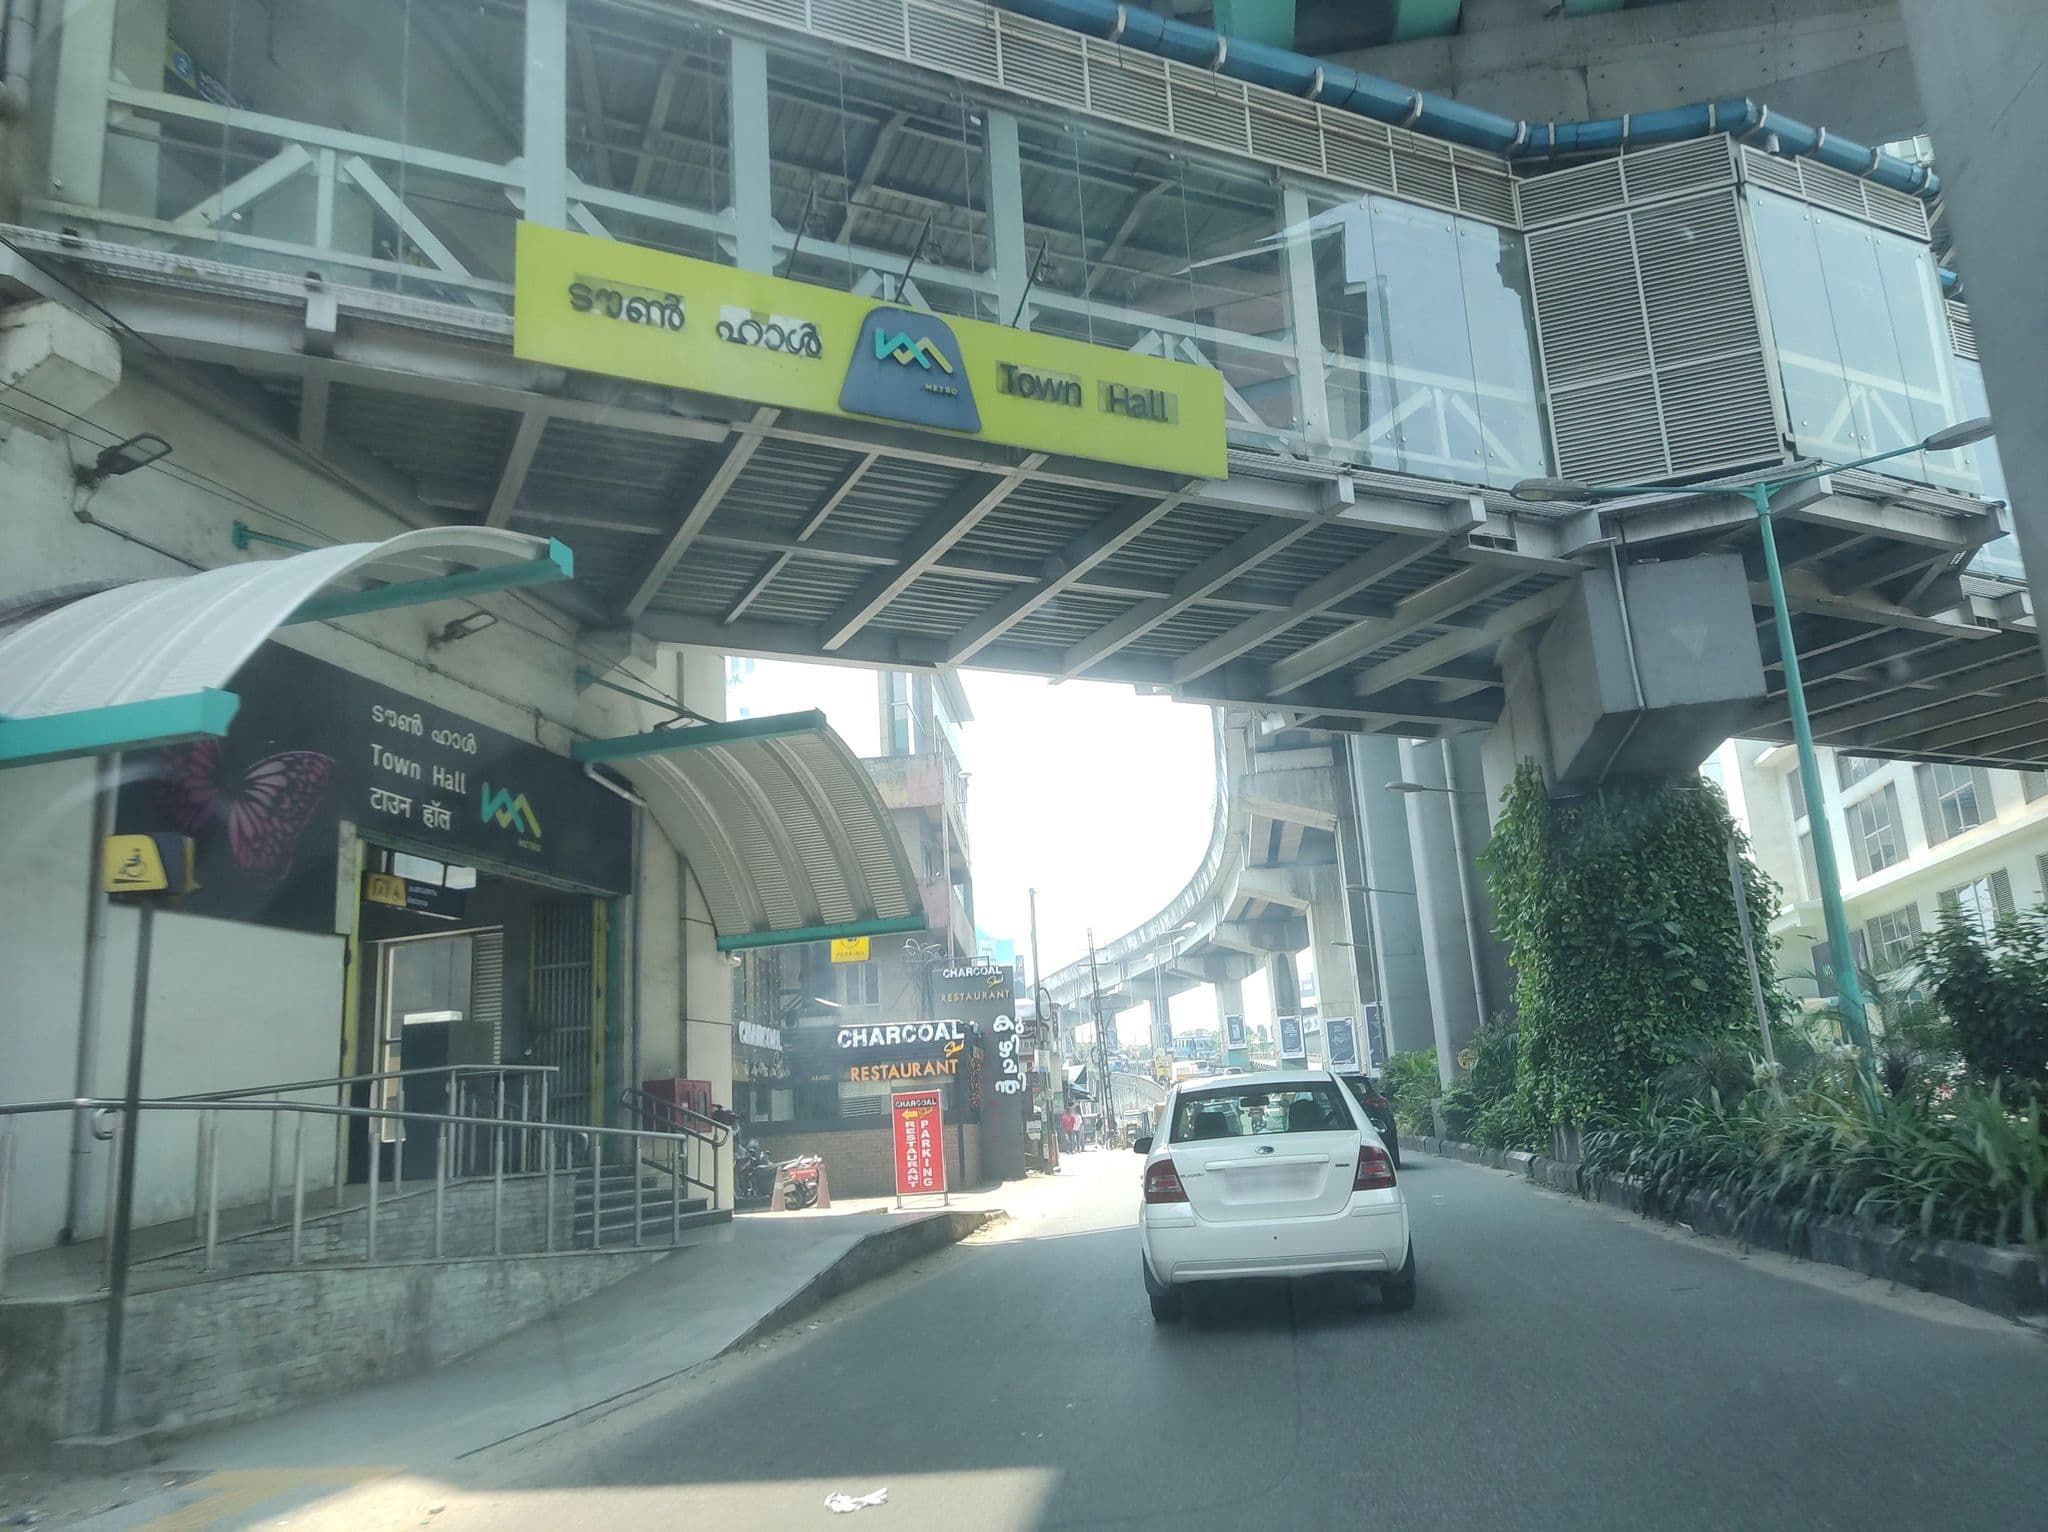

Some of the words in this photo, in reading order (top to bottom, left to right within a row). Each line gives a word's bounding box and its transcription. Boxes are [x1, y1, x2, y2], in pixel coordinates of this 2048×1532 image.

[716, 320, 822, 359] ഹാൾ
[924, 383, 958, 395] METRO
[999, 362, 1082, 408] Town
[1108, 383, 1169, 422] Hall
[431, 729, 477, 754] ഹാൾ
[370, 743, 421, 780] Town
[432, 765, 467, 795] Hall
[369, 786, 413, 818] टाउन
[422, 799, 452, 831] हॉल
[942, 965, 1003, 979] CHARCOAL
[940, 989, 1010, 1003] RESTAURANT
[837, 1021, 965, 1048] CHARCOAL
[850, 1058, 959, 1082] RESTAURANT
[895, 1098, 937, 1108] CHARCOAL
[904, 1120, 919, 1188] RESTAURANT
[920, 1119, 933, 1187] PARKING
